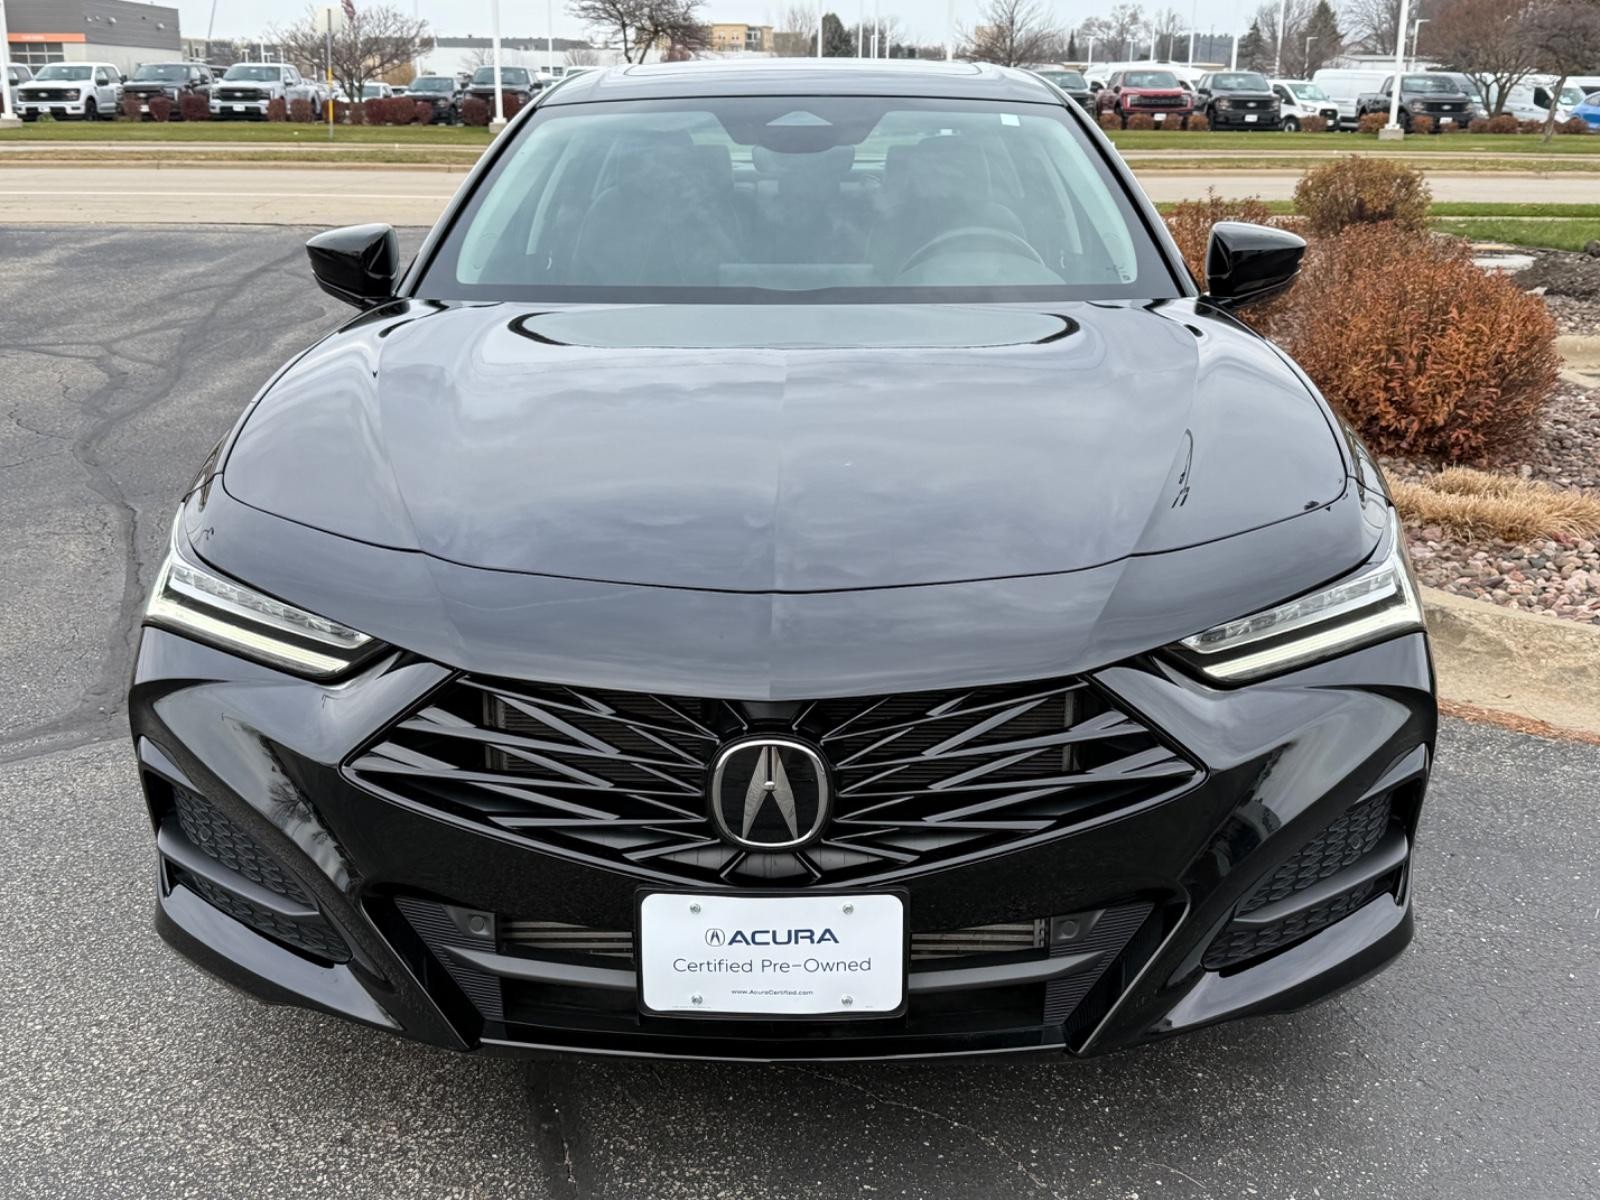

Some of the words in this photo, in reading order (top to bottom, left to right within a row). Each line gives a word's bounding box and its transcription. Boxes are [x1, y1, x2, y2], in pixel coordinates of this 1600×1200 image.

[728, 928, 839, 945] ACURA
[673, 957, 752, 973] Certified
[761, 957, 872, 973] Pre-Owned
